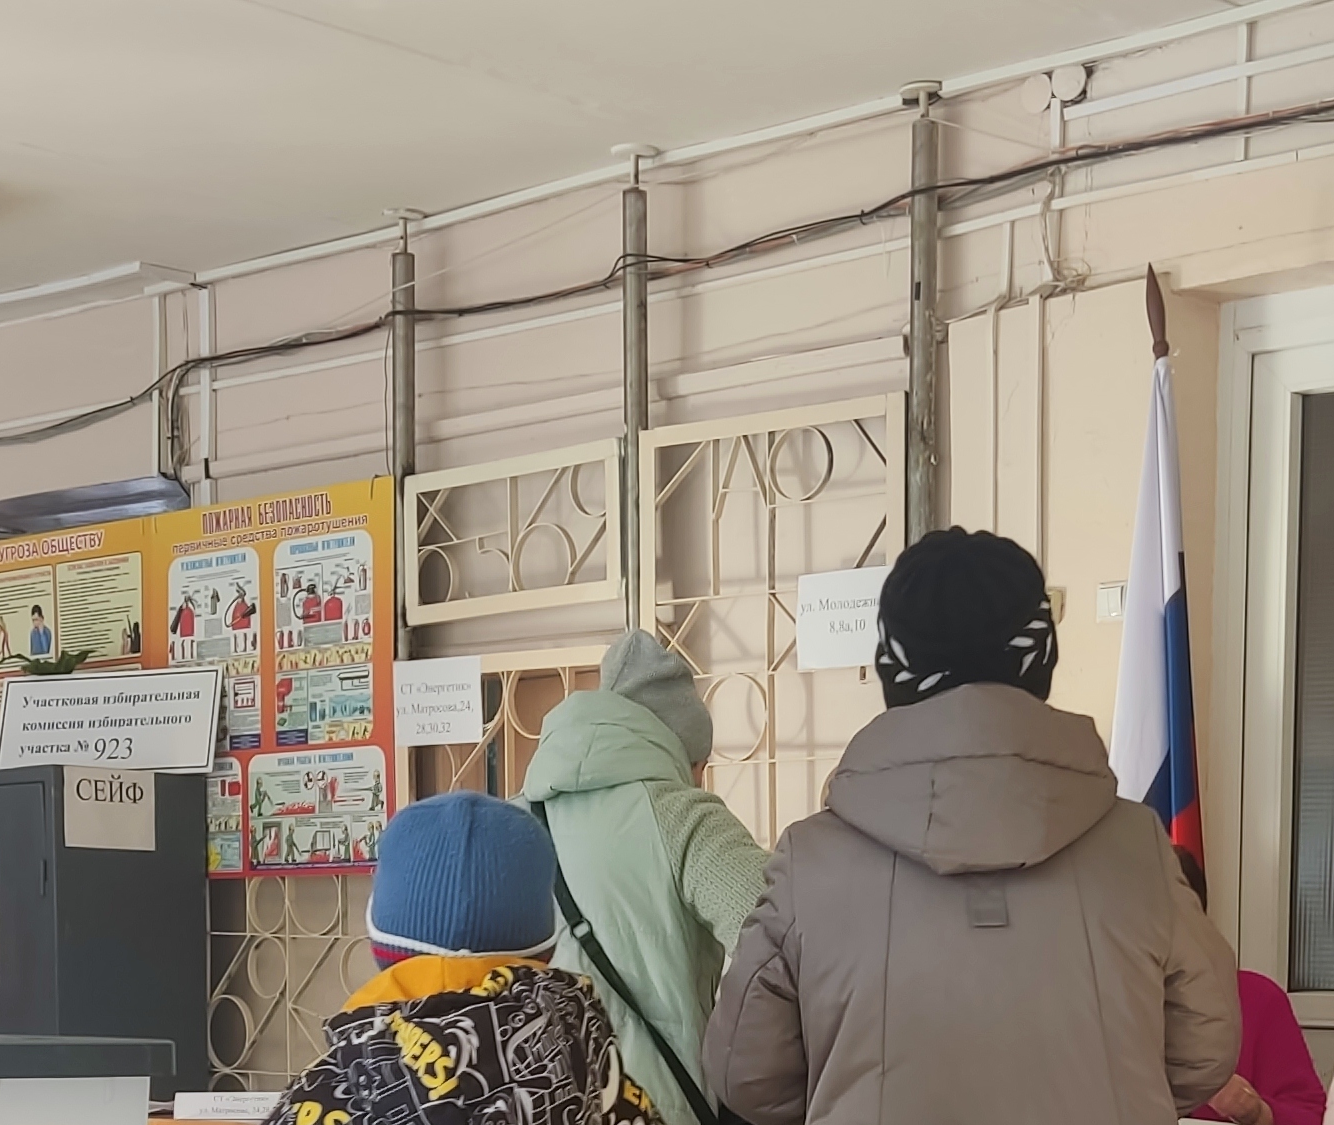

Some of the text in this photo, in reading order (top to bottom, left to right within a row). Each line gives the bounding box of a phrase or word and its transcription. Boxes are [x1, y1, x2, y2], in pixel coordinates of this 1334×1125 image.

[202, 493, 332, 534] ПОЖАРНАЯ БЕЗОПАСНОСТЬ
[41, 531, 104, 555] ОБЩЕСТВУ
[172, 514, 368, 554] первичные средства пожаротушения
[800, 603, 816, 616] ул.
[22, 690, 201, 708] Участковая избирательная
[22, 713, 192, 732] комиссия избирательного
[18, 743, 71, 758] участка
[93, 737, 134, 761] 923
[75, 773, 144, 804] СЕЙФ
